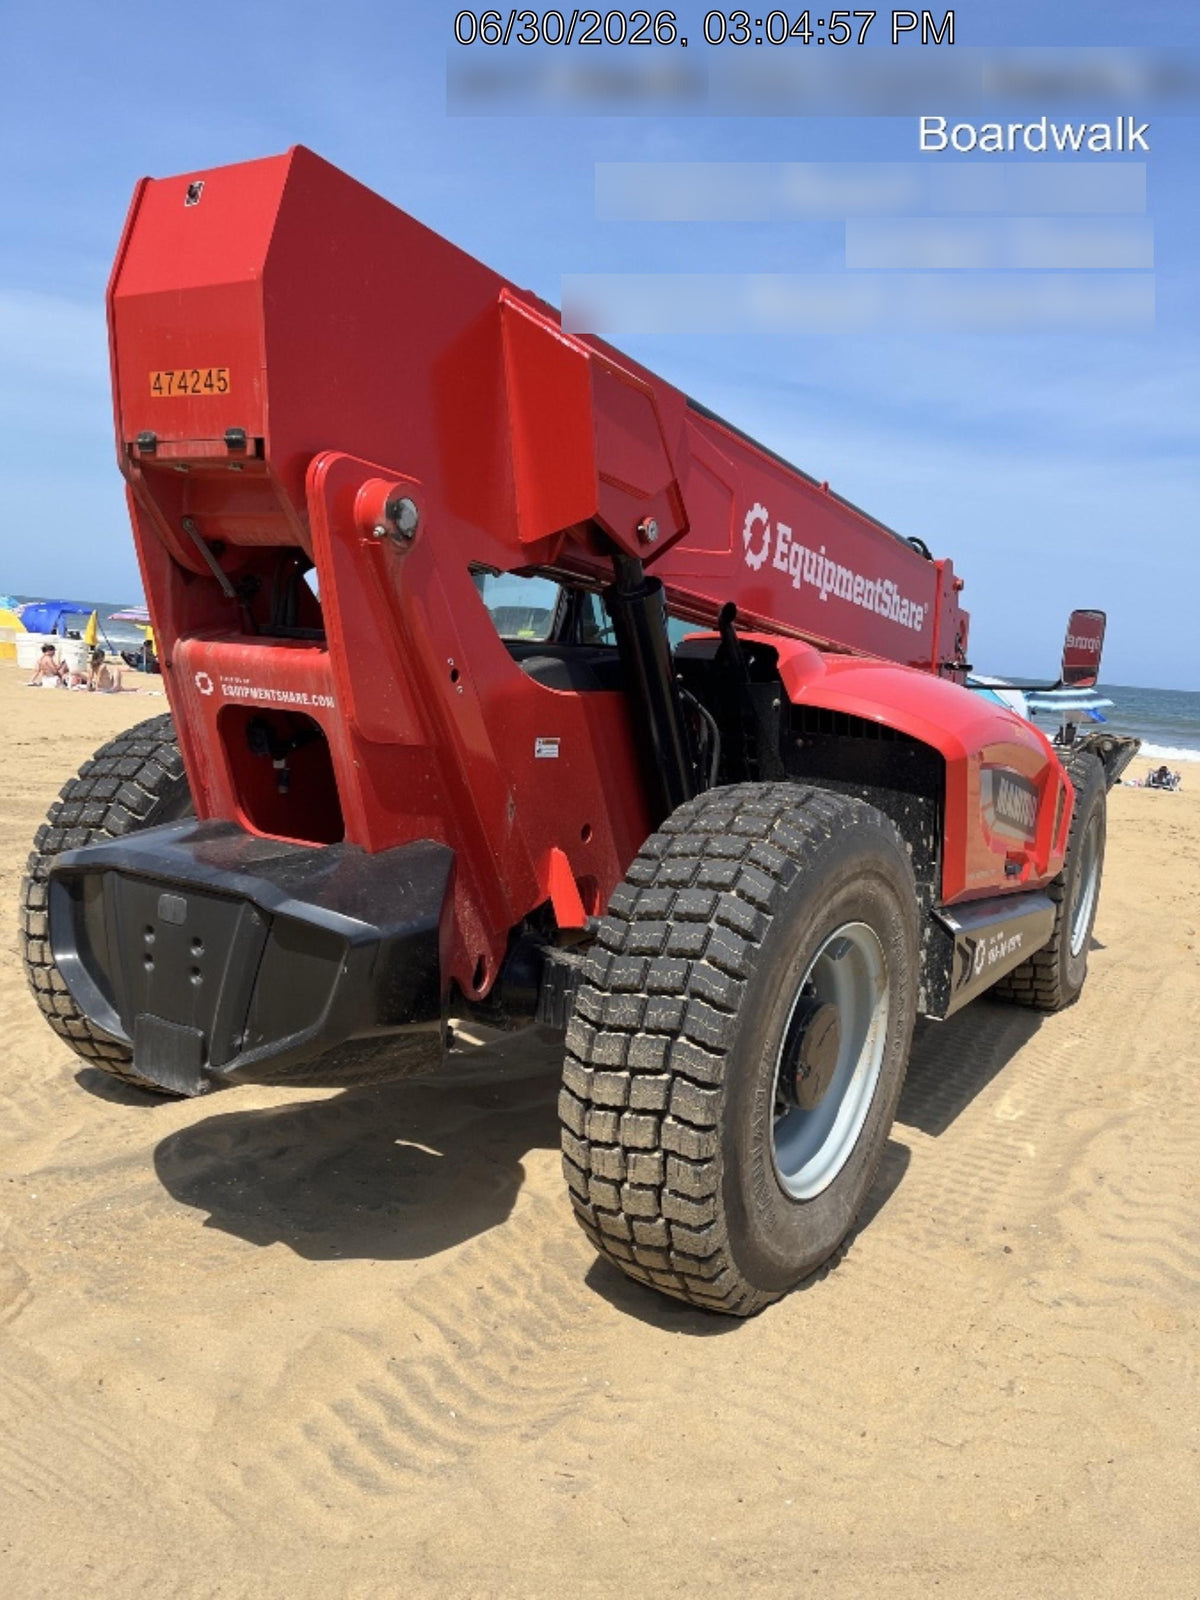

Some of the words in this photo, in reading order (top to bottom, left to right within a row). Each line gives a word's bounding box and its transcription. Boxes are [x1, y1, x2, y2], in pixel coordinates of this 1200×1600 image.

[152, 369, 229, 395] 474245
[773, 522, 925, 632] EquipmentShare
[221, 684, 335, 708] EQUIPMENTSHARE.COM
